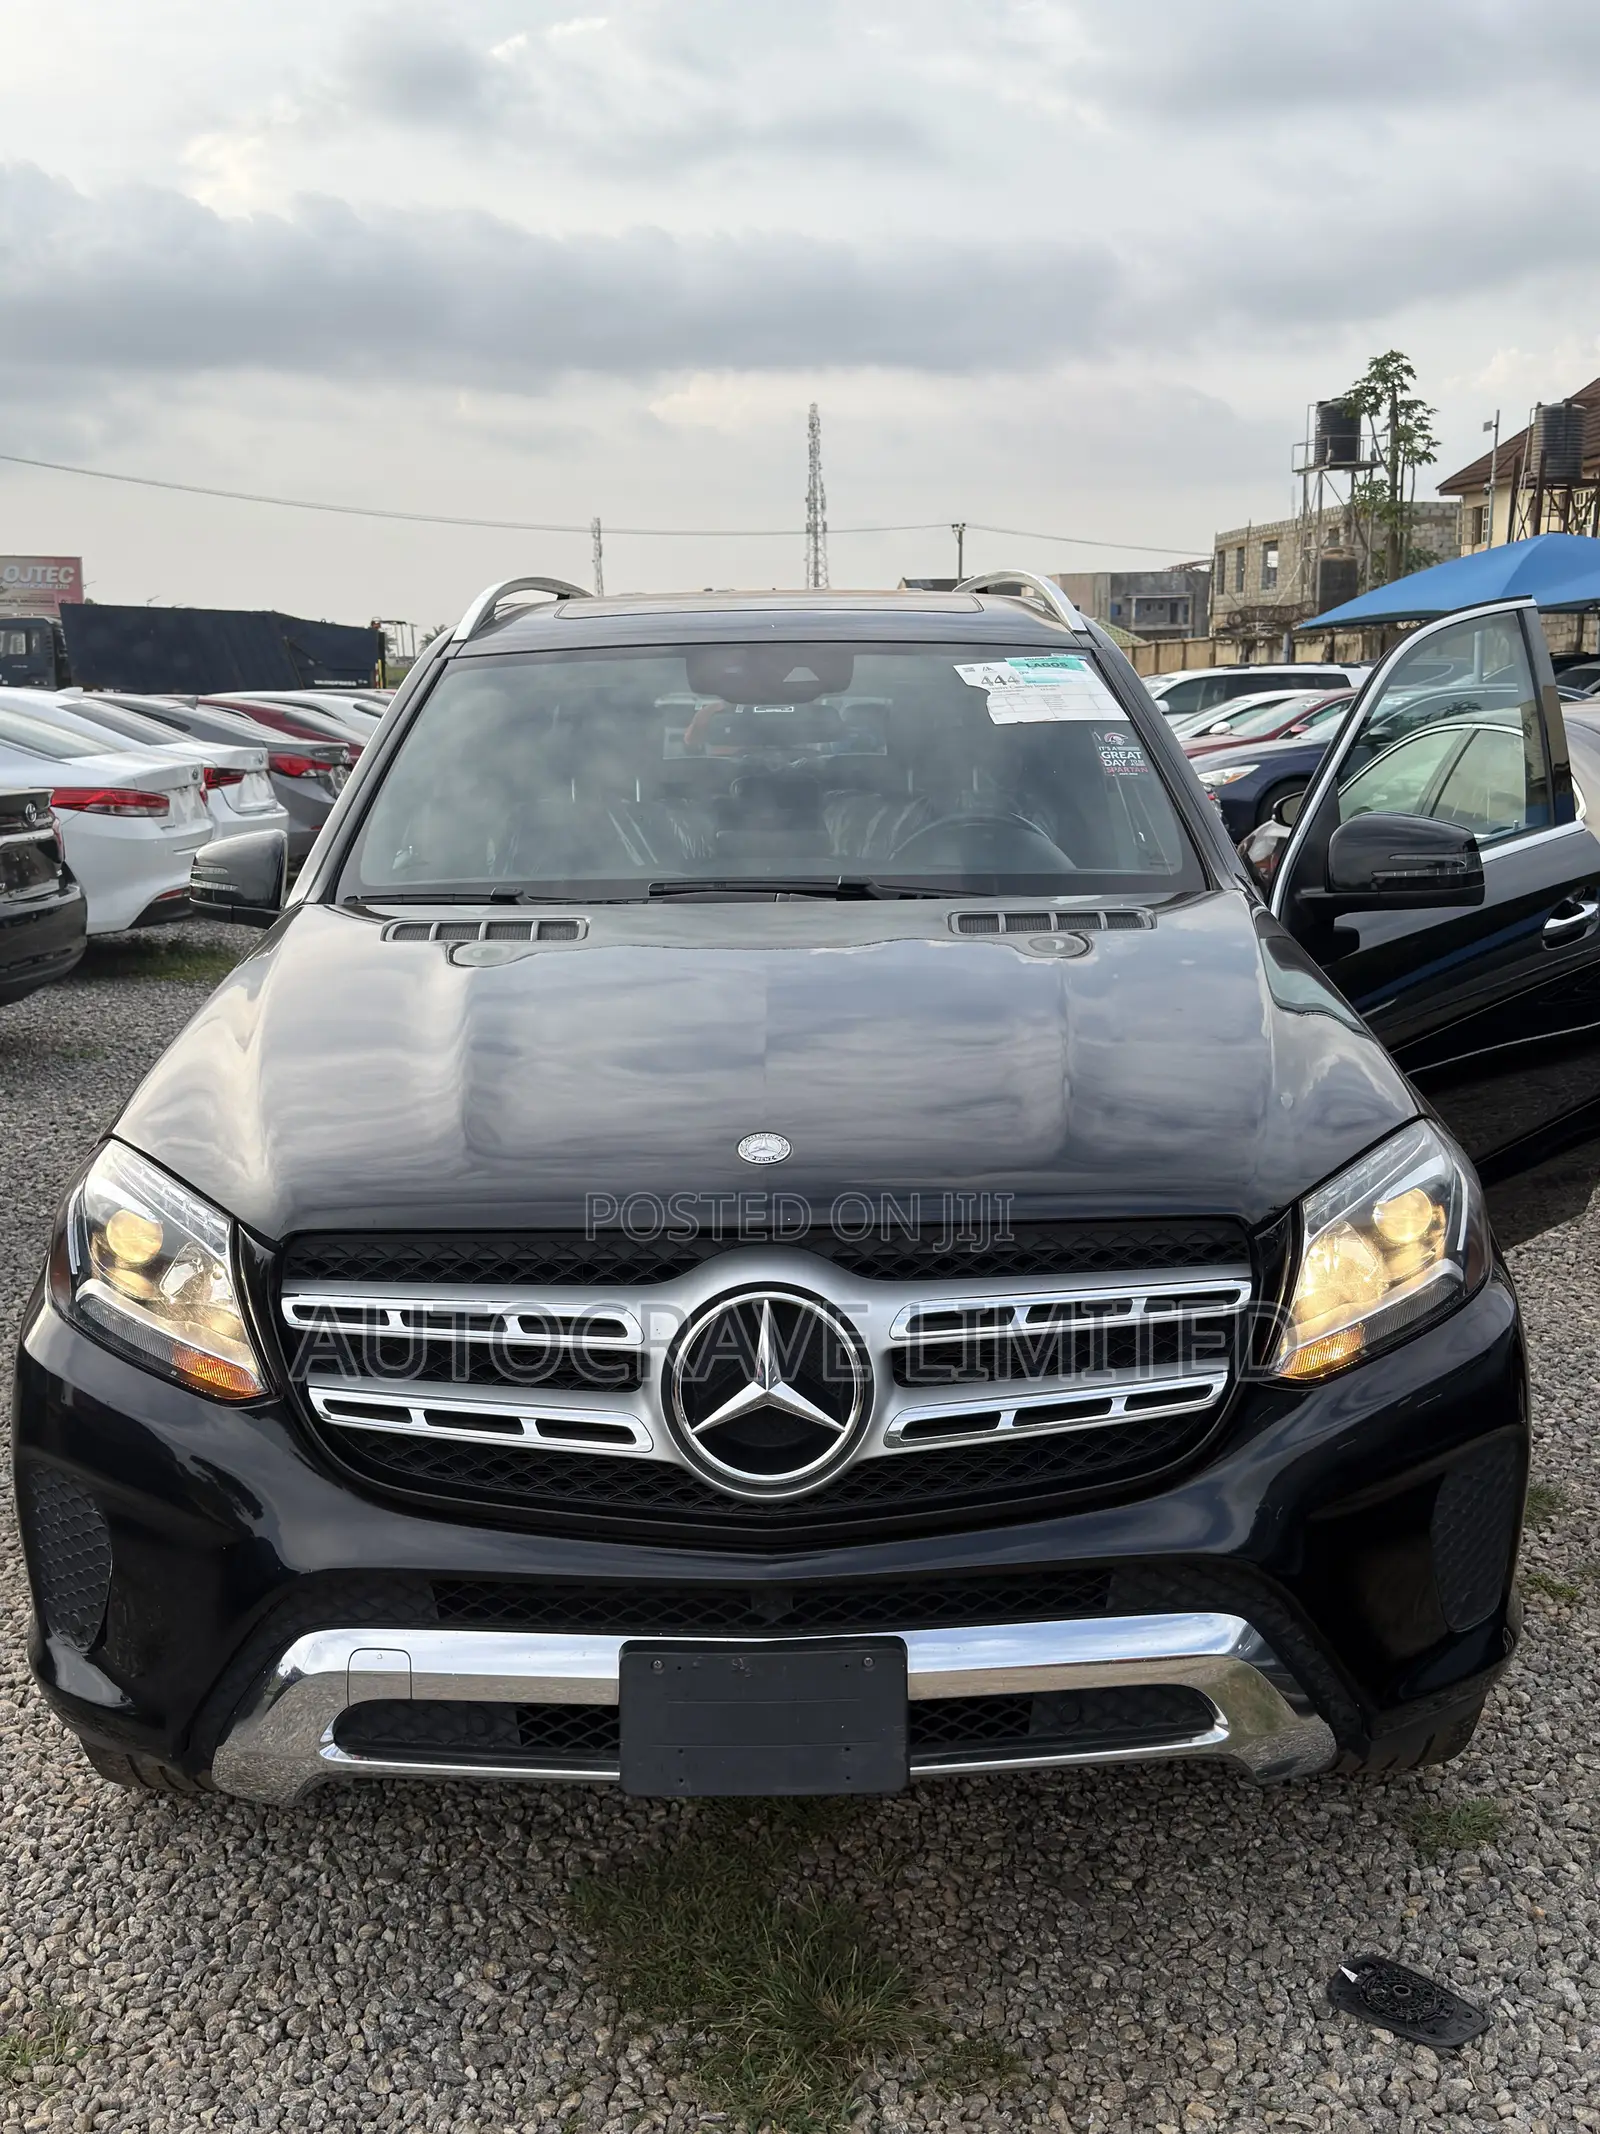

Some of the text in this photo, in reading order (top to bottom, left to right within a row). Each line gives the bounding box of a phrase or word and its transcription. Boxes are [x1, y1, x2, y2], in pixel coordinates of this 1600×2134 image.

[1101, 751, 1142, 759] GREAT
[1104, 759, 1127, 767] DAY
[1106, 766, 1149, 774] SPARTAN
